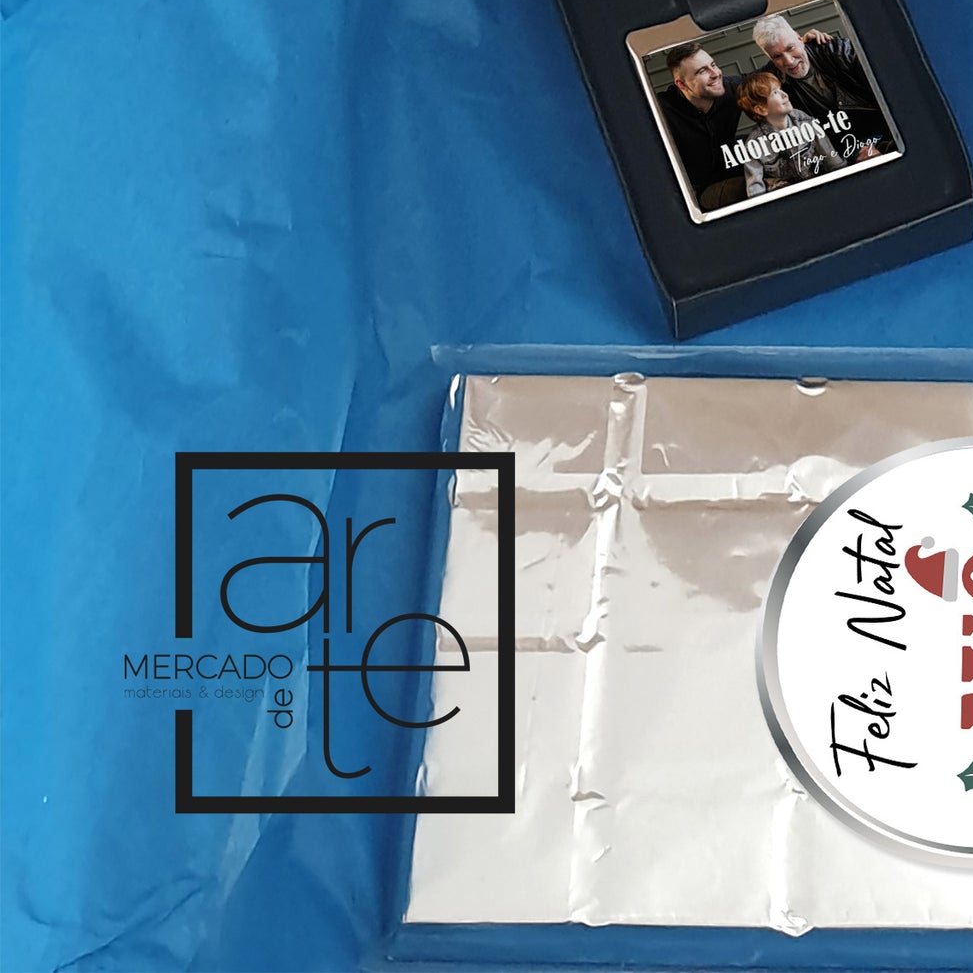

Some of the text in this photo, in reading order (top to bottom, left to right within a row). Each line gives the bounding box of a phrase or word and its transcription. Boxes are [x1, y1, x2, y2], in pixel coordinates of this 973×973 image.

[720, 109, 852, 170] Adoramos-te
[789, 133, 882, 175] Tiago e Diogo
[829, 509, 918, 777] Feliz Natal
